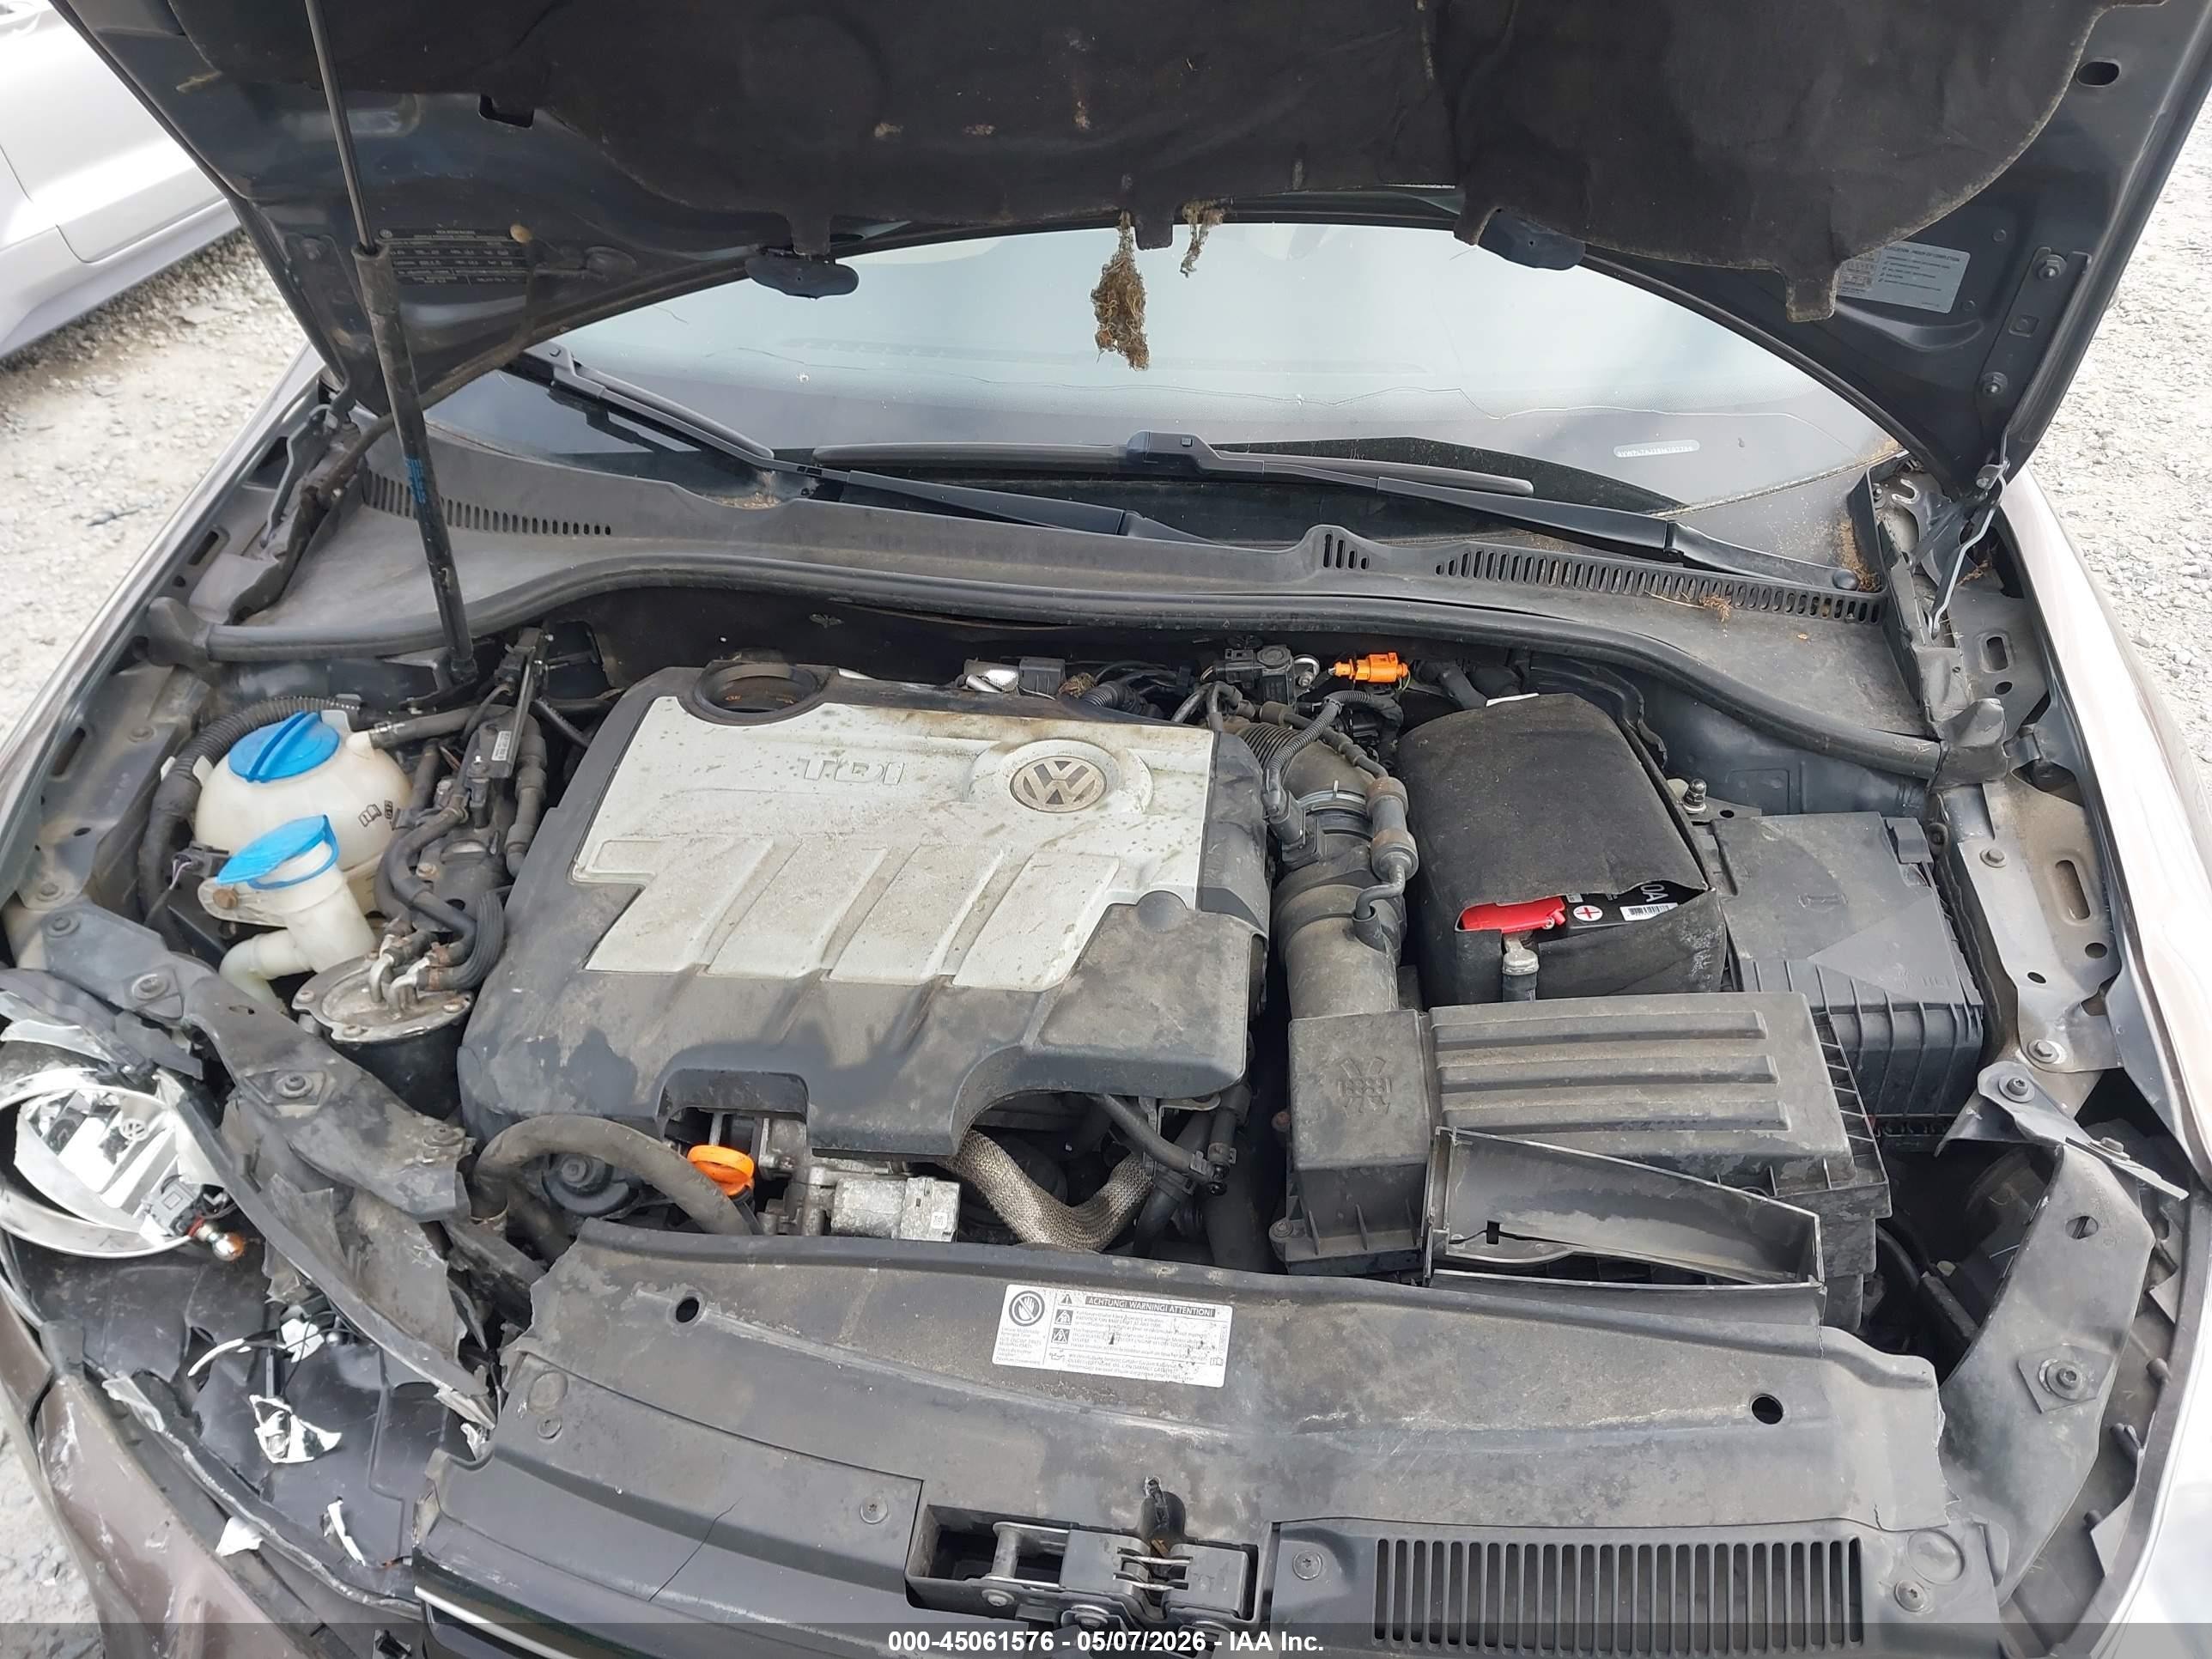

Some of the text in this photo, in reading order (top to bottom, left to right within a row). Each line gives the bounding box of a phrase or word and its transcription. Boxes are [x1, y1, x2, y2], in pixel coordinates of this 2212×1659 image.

[799, 757, 905, 785] TDI
[1088, 1299, 1127, 1308] ACHTUNG!
[1129, 1302, 1168, 1312] WARNING!
[1170, 1306, 1214, 1316] ATTENTION!
